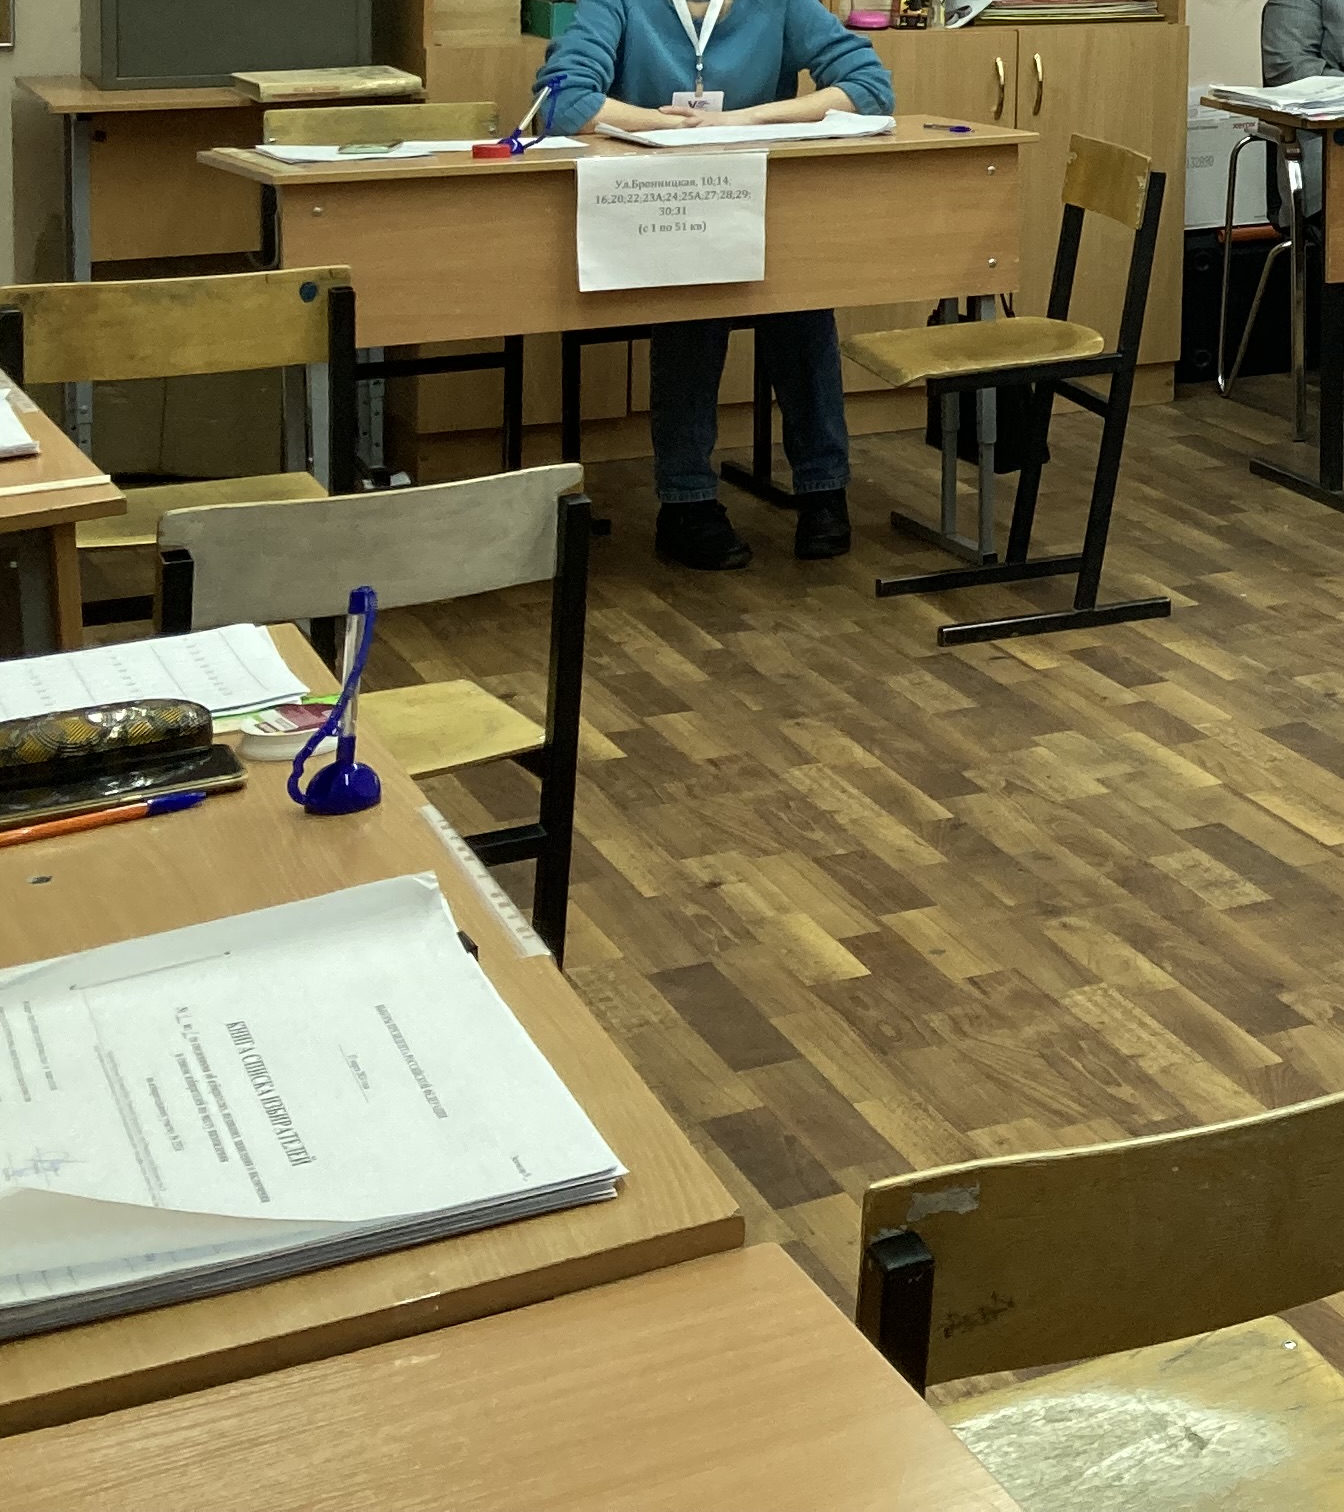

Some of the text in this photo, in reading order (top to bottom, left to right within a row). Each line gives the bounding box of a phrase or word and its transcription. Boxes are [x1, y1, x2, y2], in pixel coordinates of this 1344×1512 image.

[658, 206, 688, 216] 30;31
[659, 225, 673, 233] по
[674, 223, 688, 232] 51
[690, 221, 707, 233] кв)
[225, 1021, 318, 1167] КНИГА СПИСКА ИЗБИРАТЕЛЕЙ
